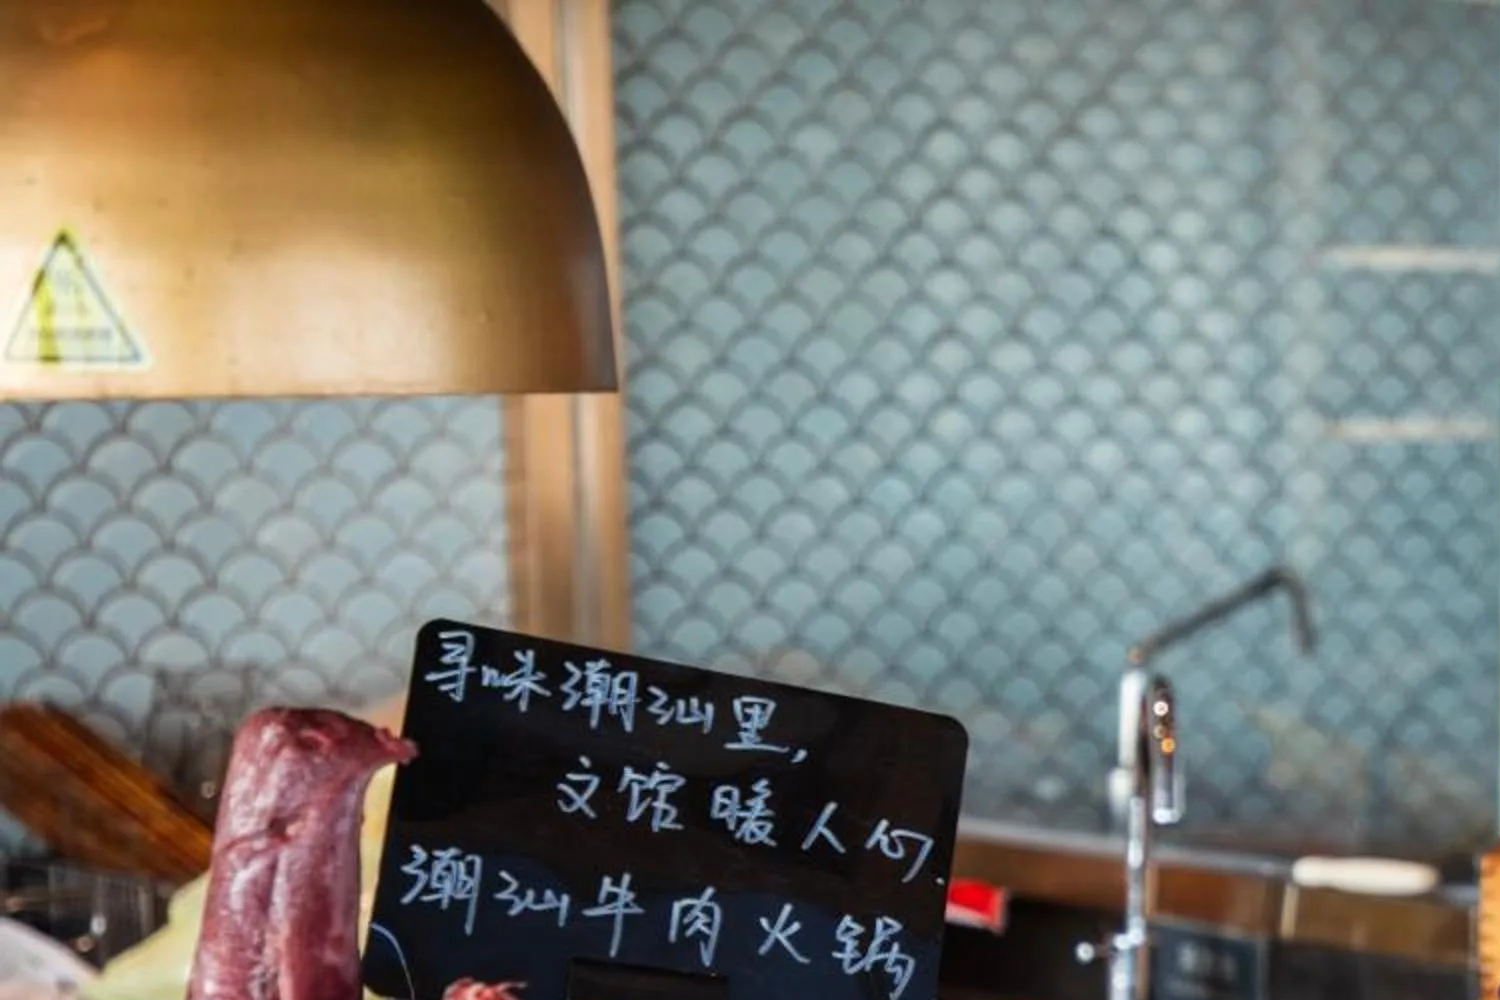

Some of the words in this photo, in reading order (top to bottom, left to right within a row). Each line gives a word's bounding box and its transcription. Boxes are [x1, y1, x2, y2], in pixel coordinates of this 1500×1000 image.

[400, 842, 915, 1000] 潮汕牛肉火锅
